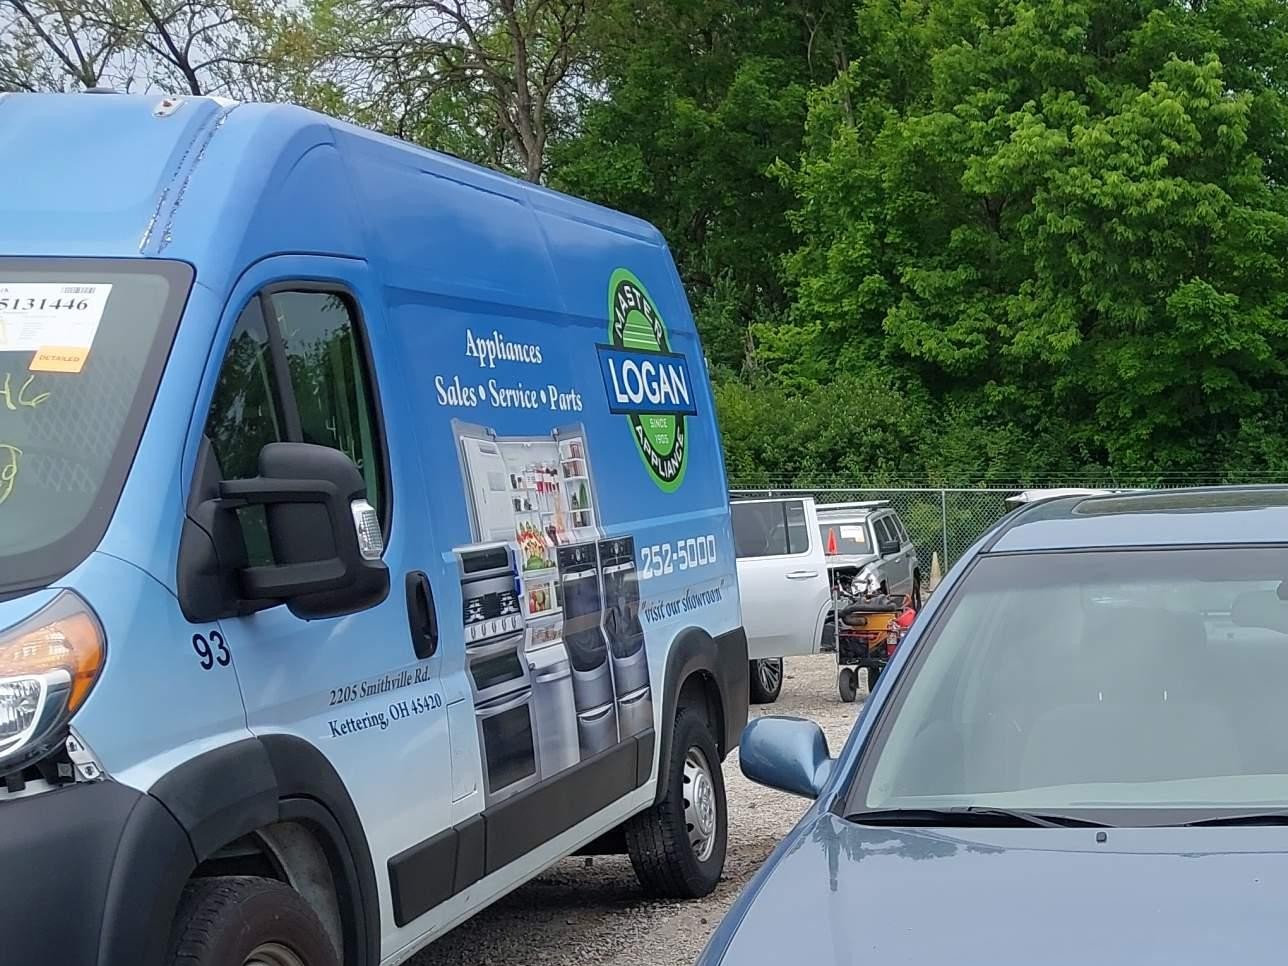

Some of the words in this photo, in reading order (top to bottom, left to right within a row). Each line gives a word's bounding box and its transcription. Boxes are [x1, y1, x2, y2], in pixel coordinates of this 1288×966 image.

[615, 285, 663, 345] MASTER
[465, 328, 542, 368] Appliances
[434, 375, 477, 407] Sales
[488, 379, 538, 409] Service
[548, 385, 583, 412] Parts
[608, 358, 689, 405] LOGAN
[636, 426, 684, 478] APPLIANCE
[641, 535, 717, 579] 252-5000
[666, 601, 681, 617] our
[192, 630, 230, 670] 93
[329, 684, 358, 706] 2205
[359, 670, 412, 698] Smithville
[414, 665, 431, 684] Rd.
[328, 712, 389, 738] Kettering,
[389, 700, 410, 720] OH
[411, 693, 442, 715] 45420
